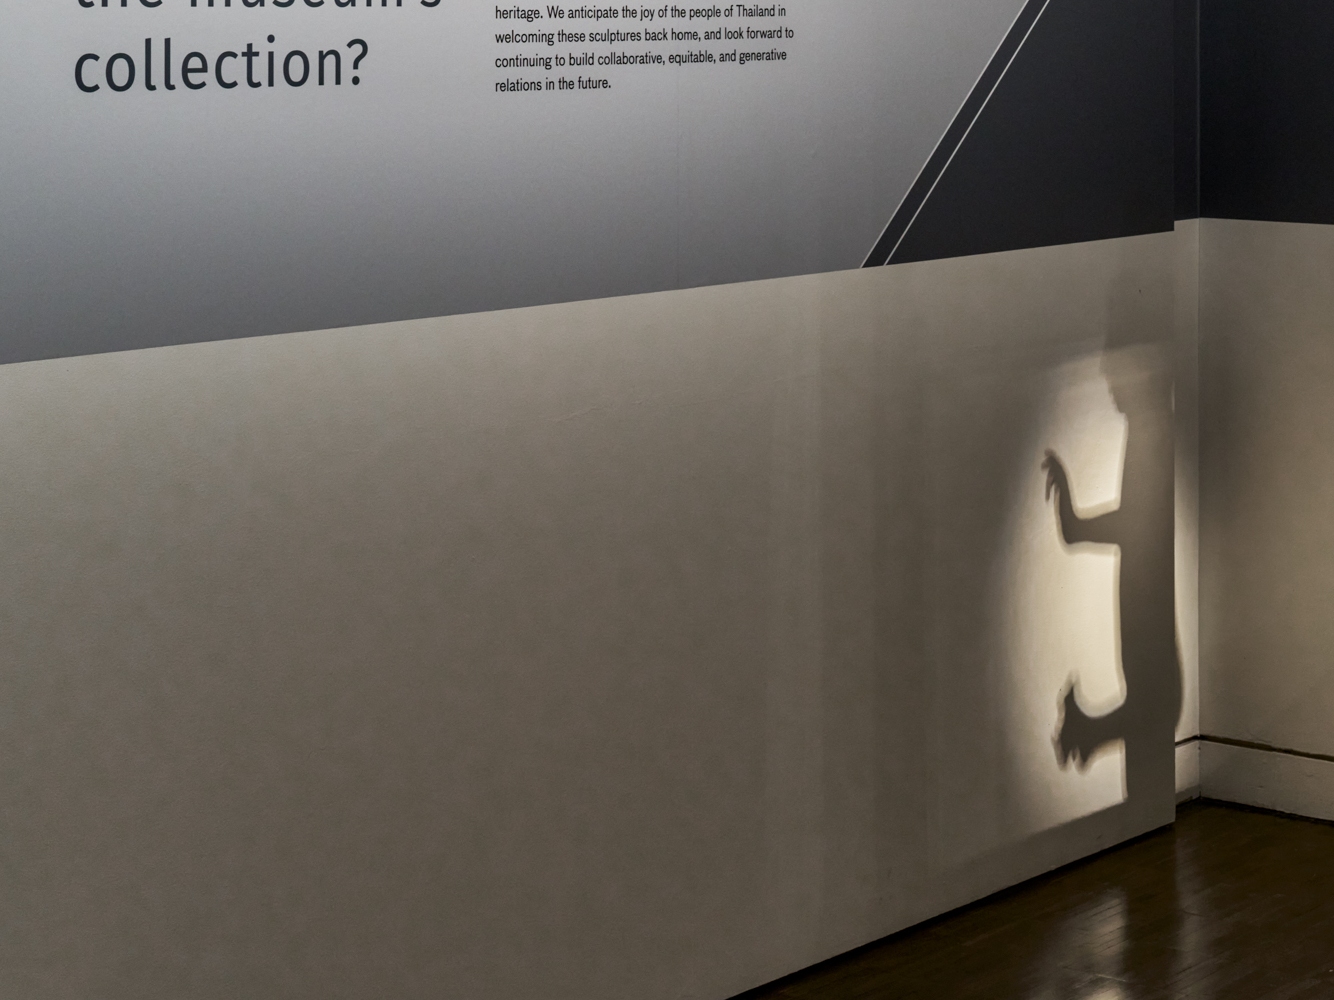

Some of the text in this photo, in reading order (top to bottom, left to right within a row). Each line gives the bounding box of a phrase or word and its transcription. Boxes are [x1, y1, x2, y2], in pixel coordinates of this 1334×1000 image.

[496, 4, 786, 22] heritage. We anticipate the joy of the people of Thailand in
[495, 26, 794, 46] welcoming these sculptures back home, and look forward to
[75, 34, 368, 92] collection?
